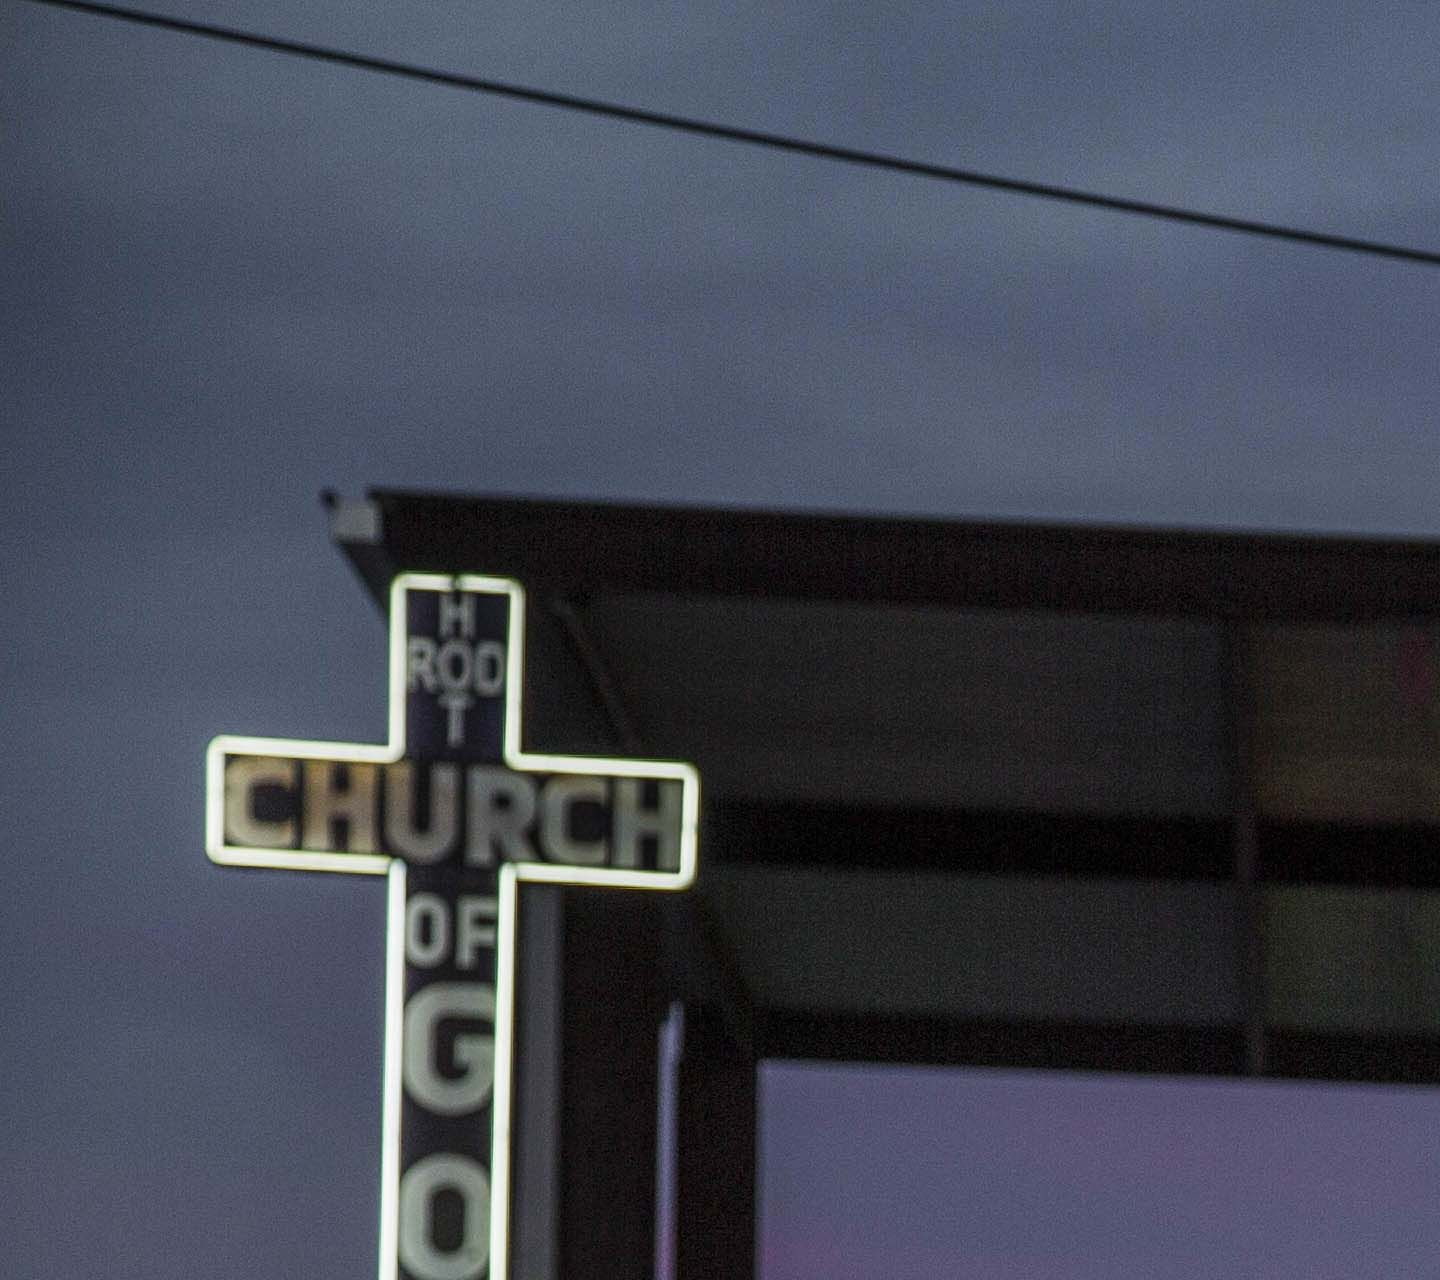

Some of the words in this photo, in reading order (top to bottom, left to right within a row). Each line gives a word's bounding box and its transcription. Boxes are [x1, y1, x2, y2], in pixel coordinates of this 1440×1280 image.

[406, 635, 505, 698] ROD
[223, 755, 683, 872] CHURCH
[403, 892, 501, 970] OF
